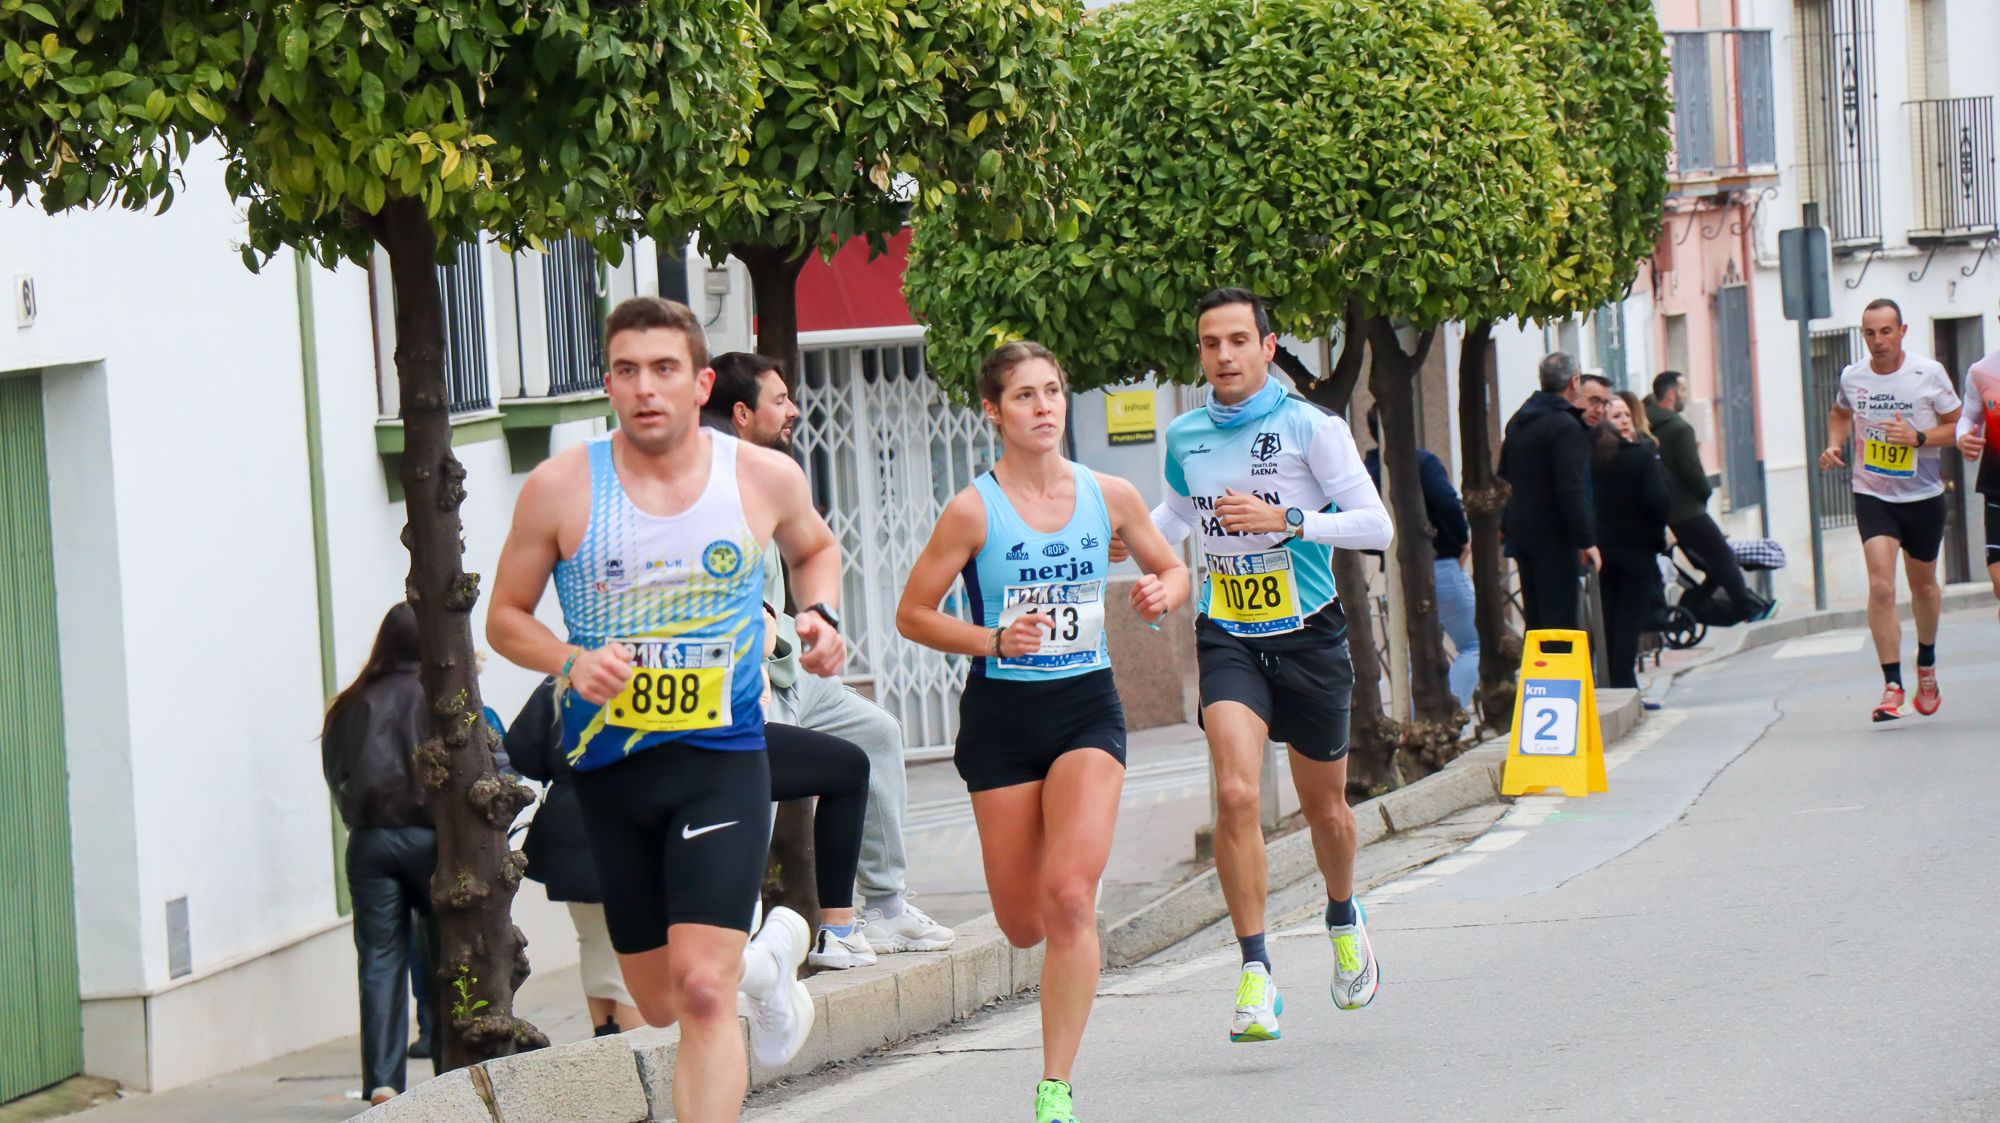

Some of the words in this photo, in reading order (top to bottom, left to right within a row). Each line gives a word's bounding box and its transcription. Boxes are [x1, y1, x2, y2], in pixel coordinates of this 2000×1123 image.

[1870, 401, 1913, 410] MARATÓN
[1871, 443, 1909, 464] 1197
[1043, 542, 1069, 556] TROPS
[1018, 557, 1094, 582] nerja
[1219, 576, 1282, 610] 1028
[1026, 606, 1079, 641] 13
[632, 672, 700, 716] 898
[1525, 684, 1547, 696] km
[1534, 707, 1559, 741] 2
